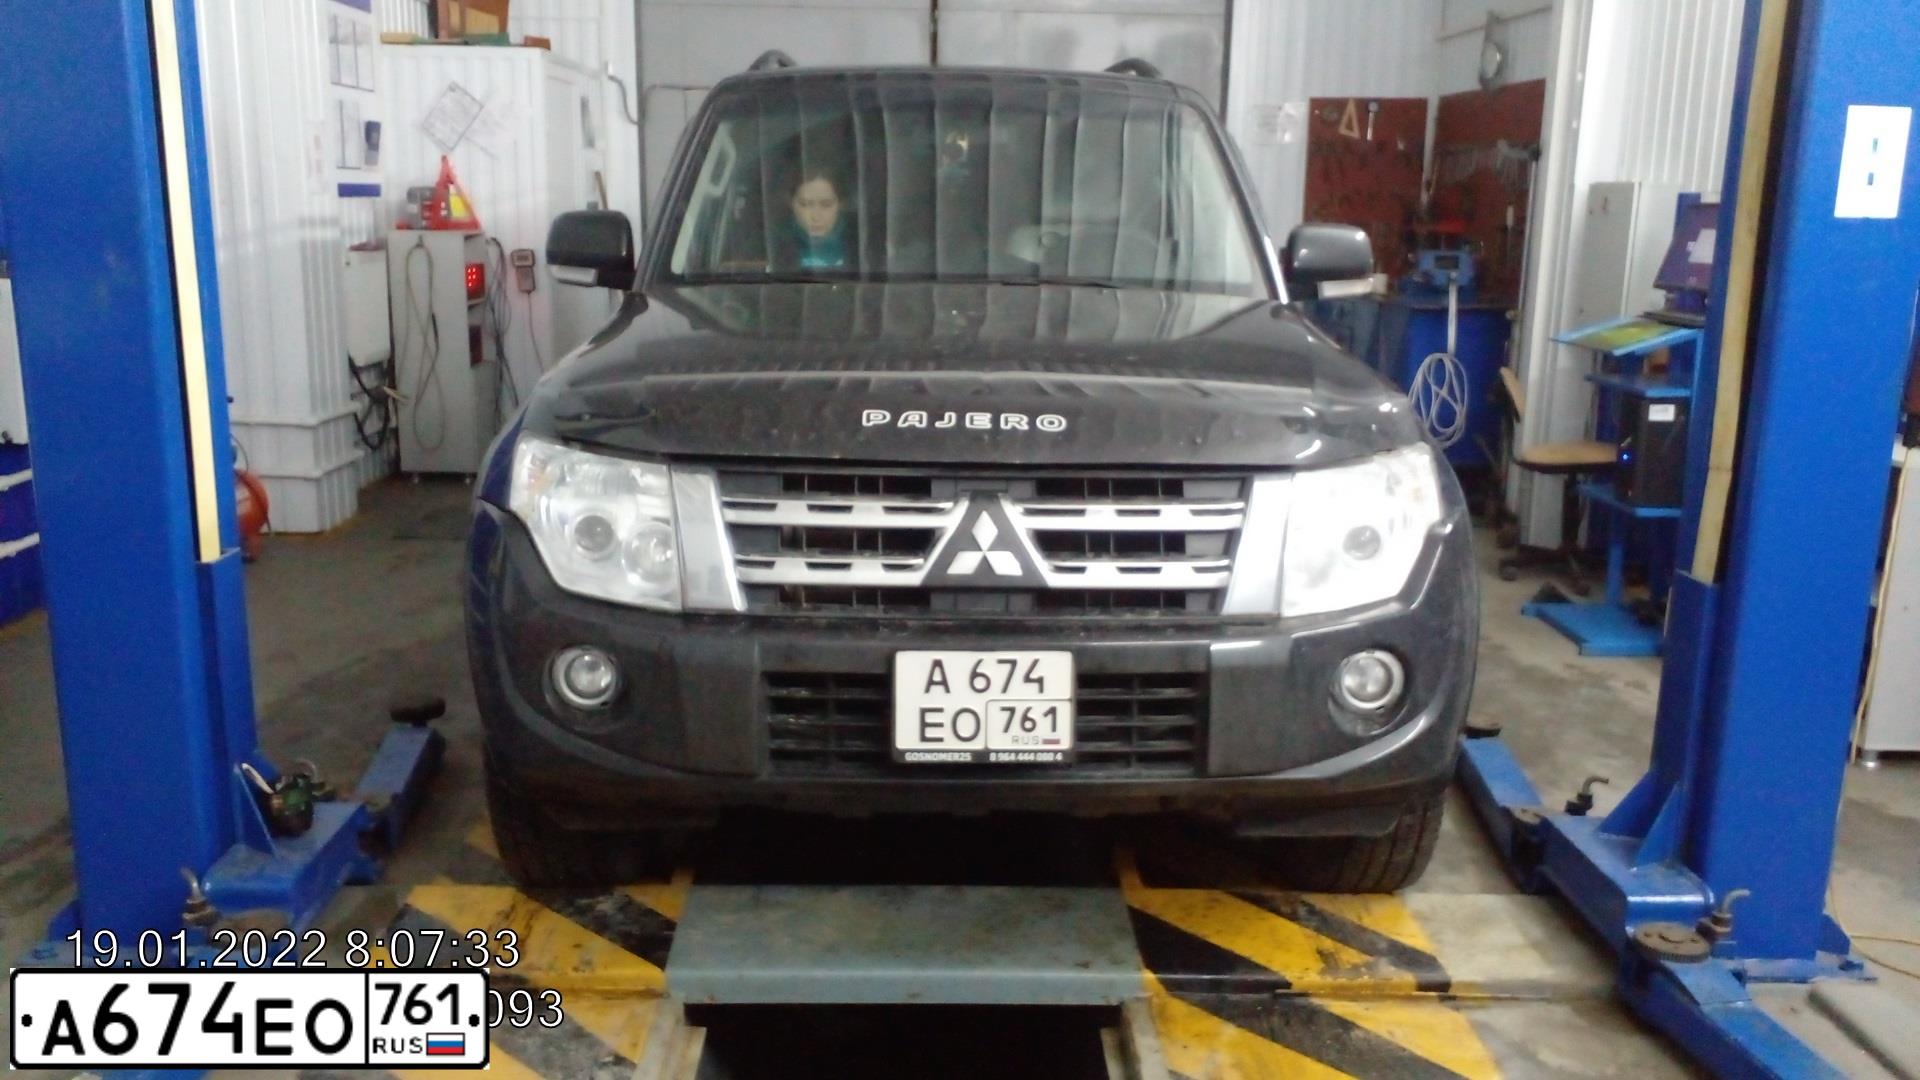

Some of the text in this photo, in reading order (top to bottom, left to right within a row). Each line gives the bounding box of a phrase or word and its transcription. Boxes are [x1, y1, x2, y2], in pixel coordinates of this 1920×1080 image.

[862, 409, 1067, 432] PAJERO
[924, 658, 1044, 694] A 674
[919, 706, 1057, 743] EO 761
[1011, 735, 1041, 745] RUS
